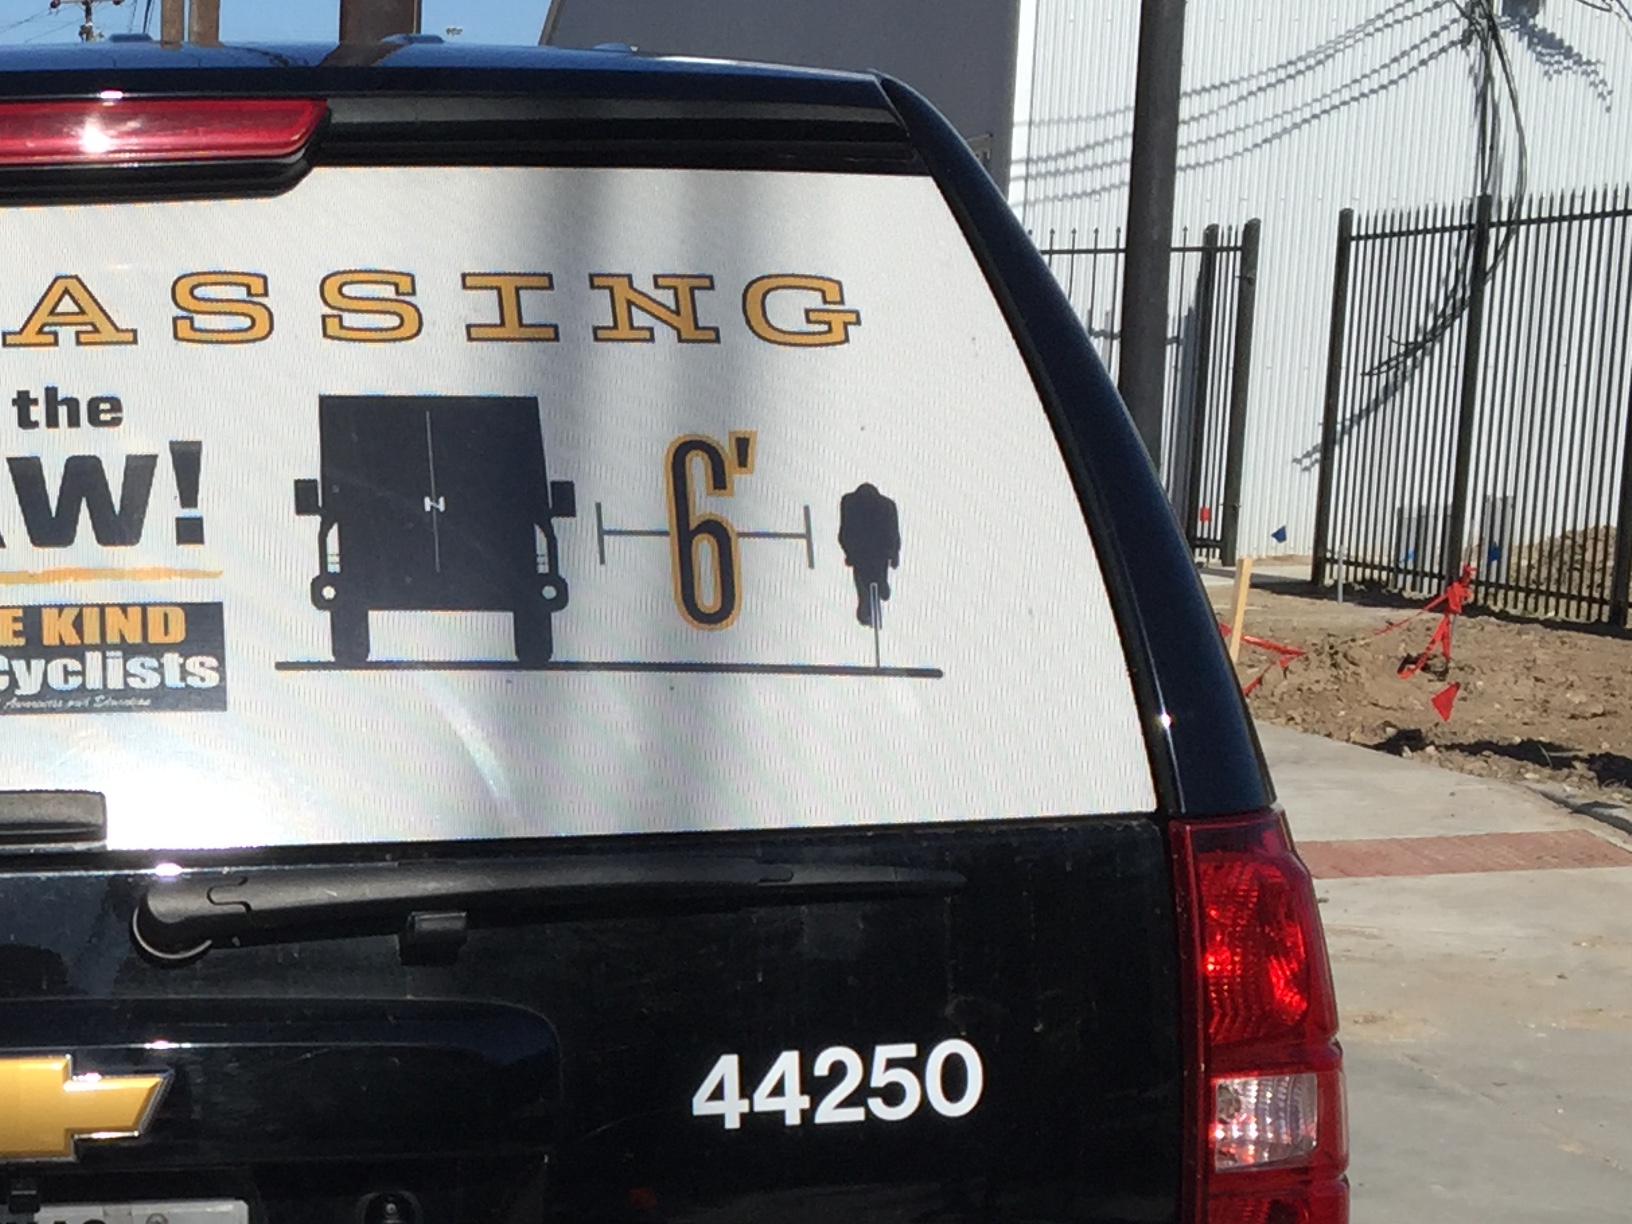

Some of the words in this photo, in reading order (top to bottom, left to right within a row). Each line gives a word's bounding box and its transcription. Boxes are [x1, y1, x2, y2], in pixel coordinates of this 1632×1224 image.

[13, 385, 124, 430] the
[664, 430, 757, 632] 6'
[41, 606, 187, 646] KIND
[692, 1038, 983, 1130] 44250
